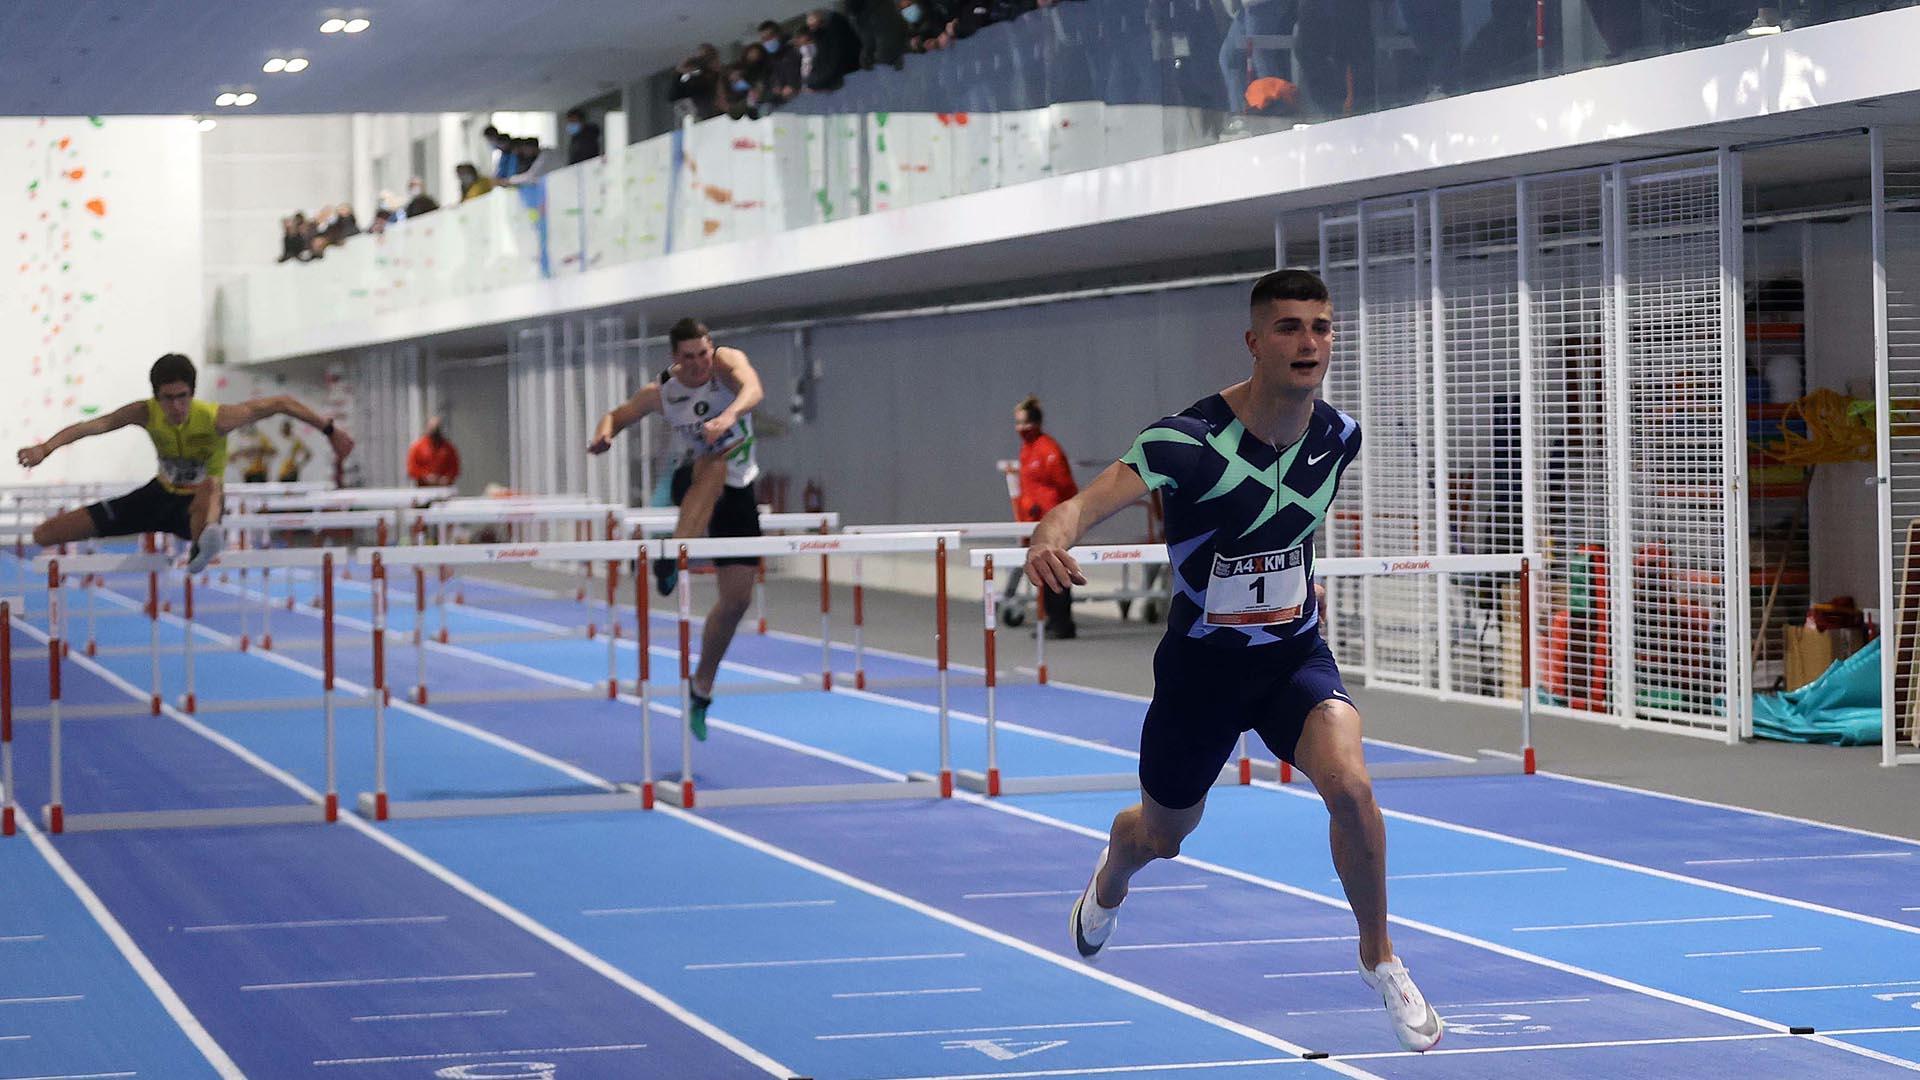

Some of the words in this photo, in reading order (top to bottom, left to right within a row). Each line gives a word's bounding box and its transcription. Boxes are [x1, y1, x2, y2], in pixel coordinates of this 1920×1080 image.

[1102, 549, 1142, 560] polanik
[1233, 554, 1285, 574] A4XKM
[1392, 560, 1430, 571] polanik
[1249, 576, 1265, 604] 1
[939, 1038, 1069, 1061] 4
